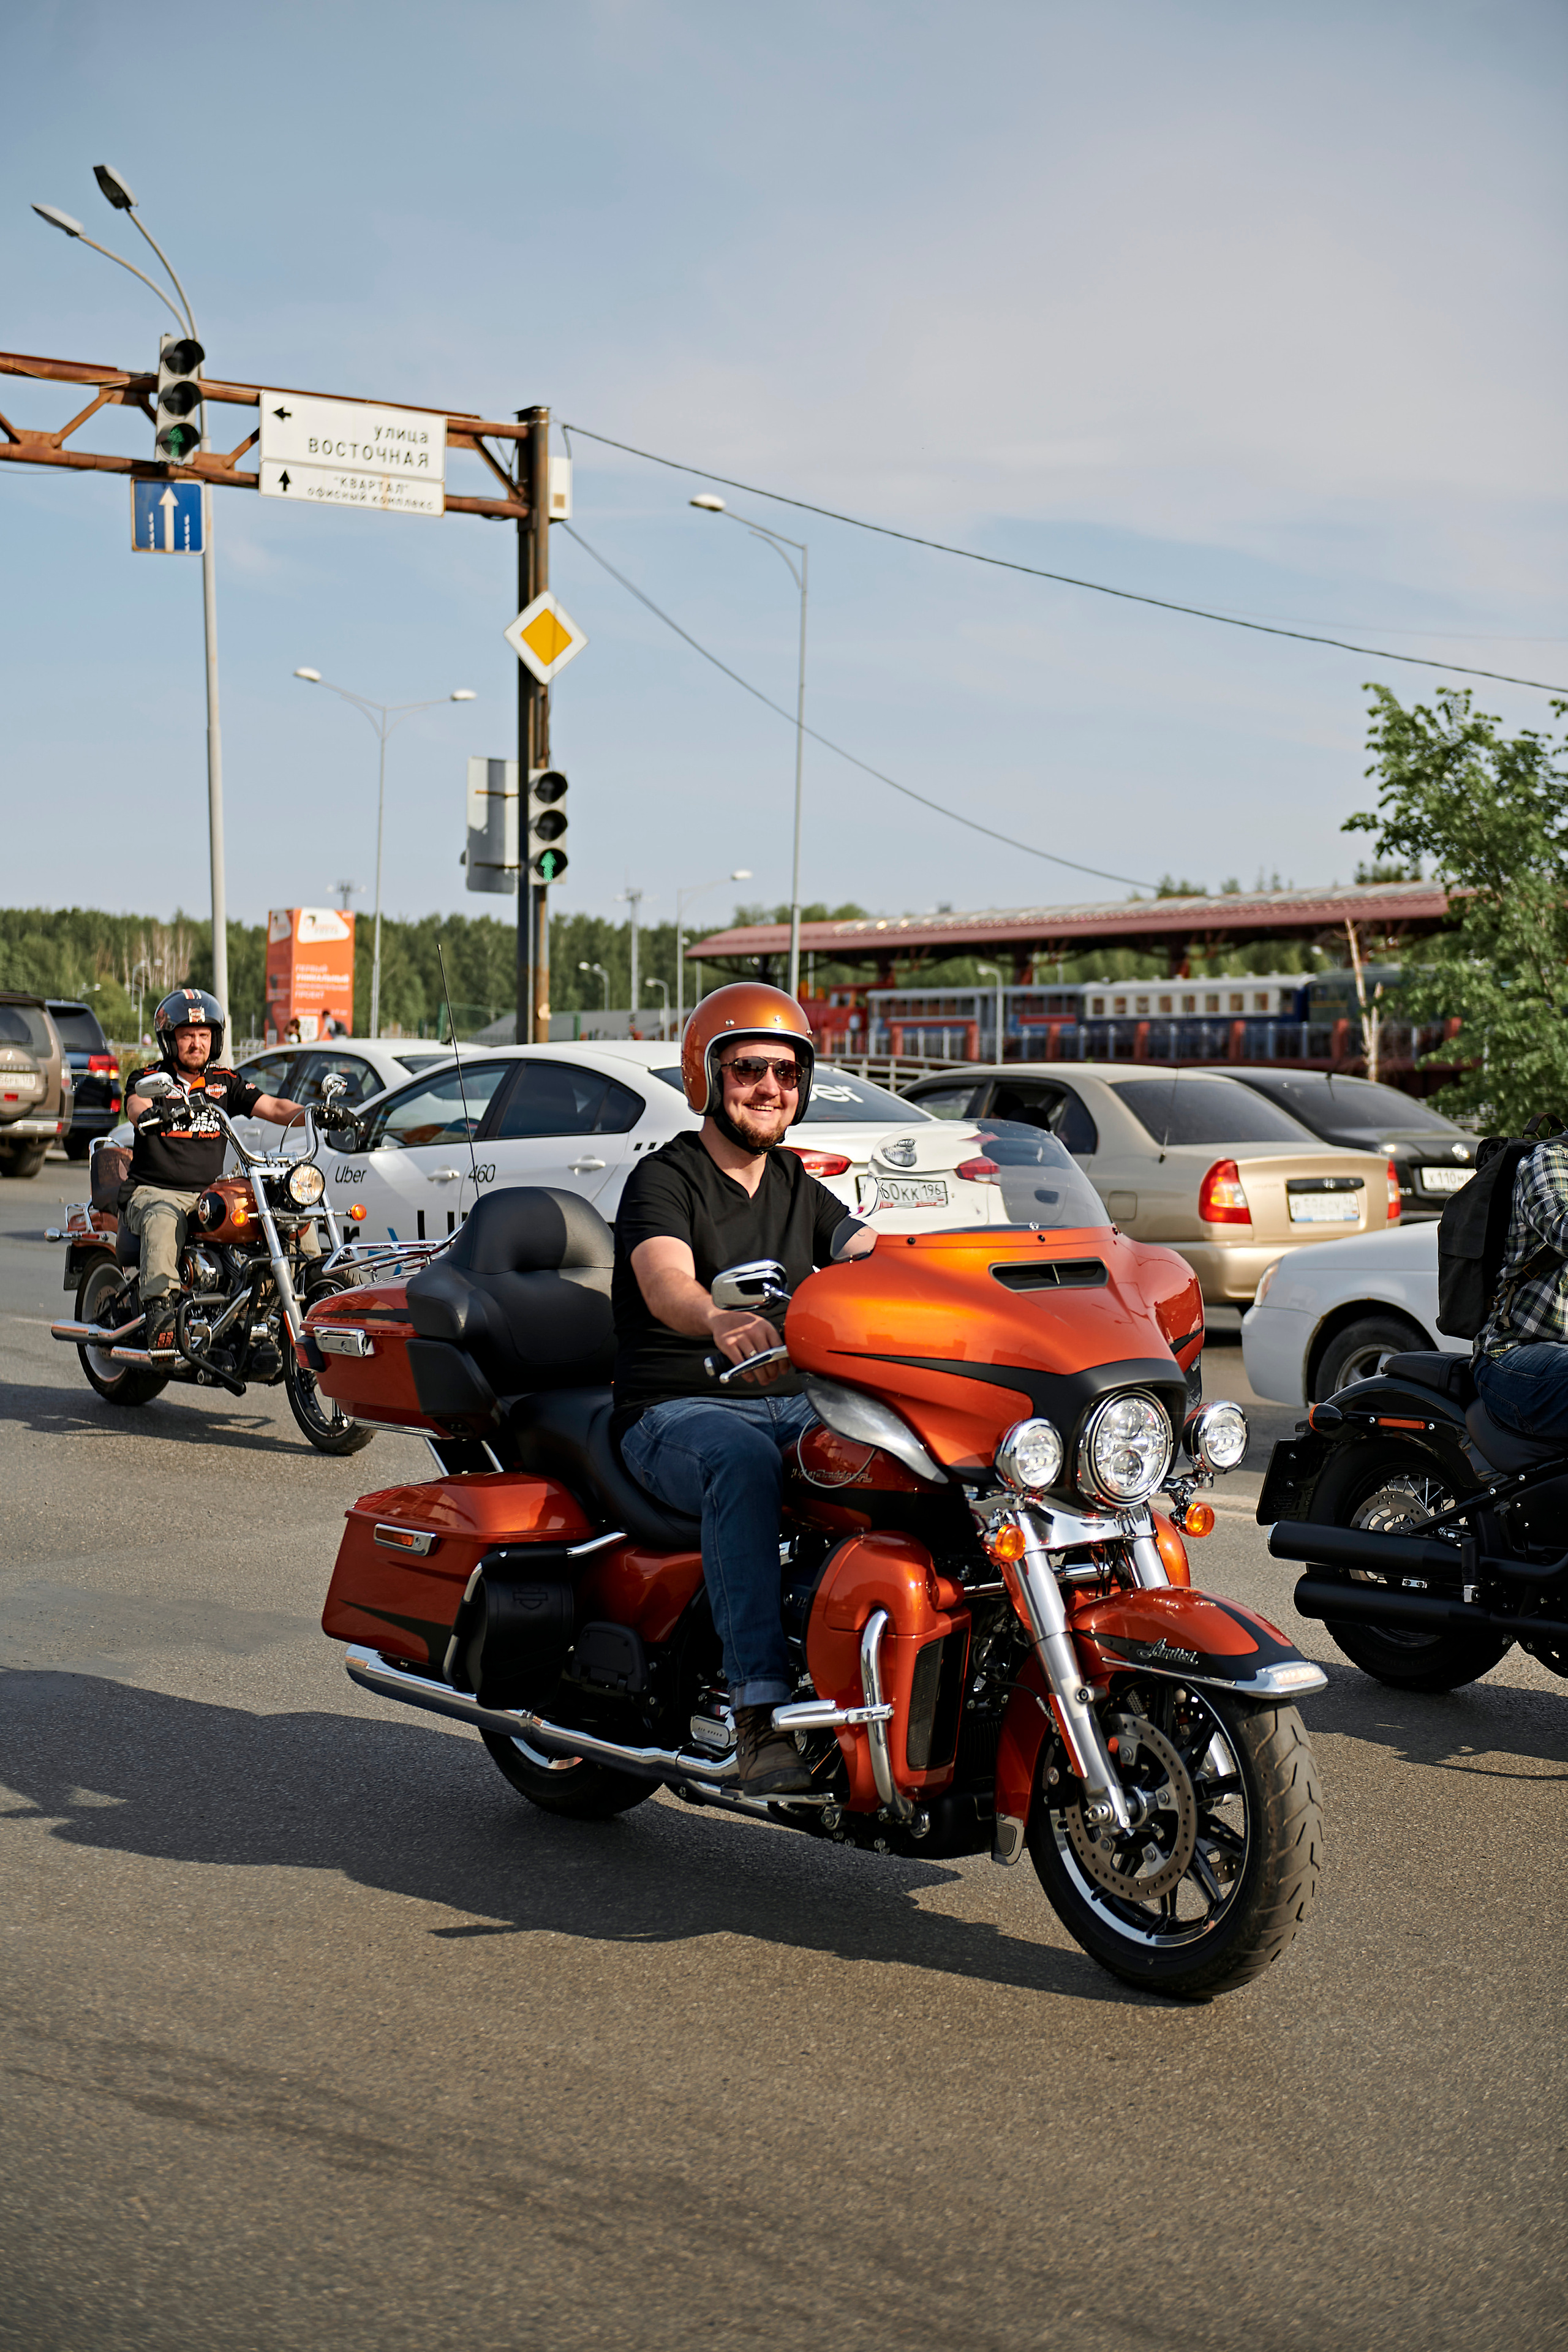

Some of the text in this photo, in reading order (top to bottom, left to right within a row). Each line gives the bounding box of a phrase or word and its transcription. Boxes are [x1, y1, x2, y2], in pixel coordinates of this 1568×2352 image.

[374, 425, 429, 445] улица
[308, 437, 429, 468] ВОСТОЧНАЯ
[307, 486, 434, 510] офисный комплекс
[334, 1165, 367, 1183] Uber
[468, 1164, 496, 1183] 460
